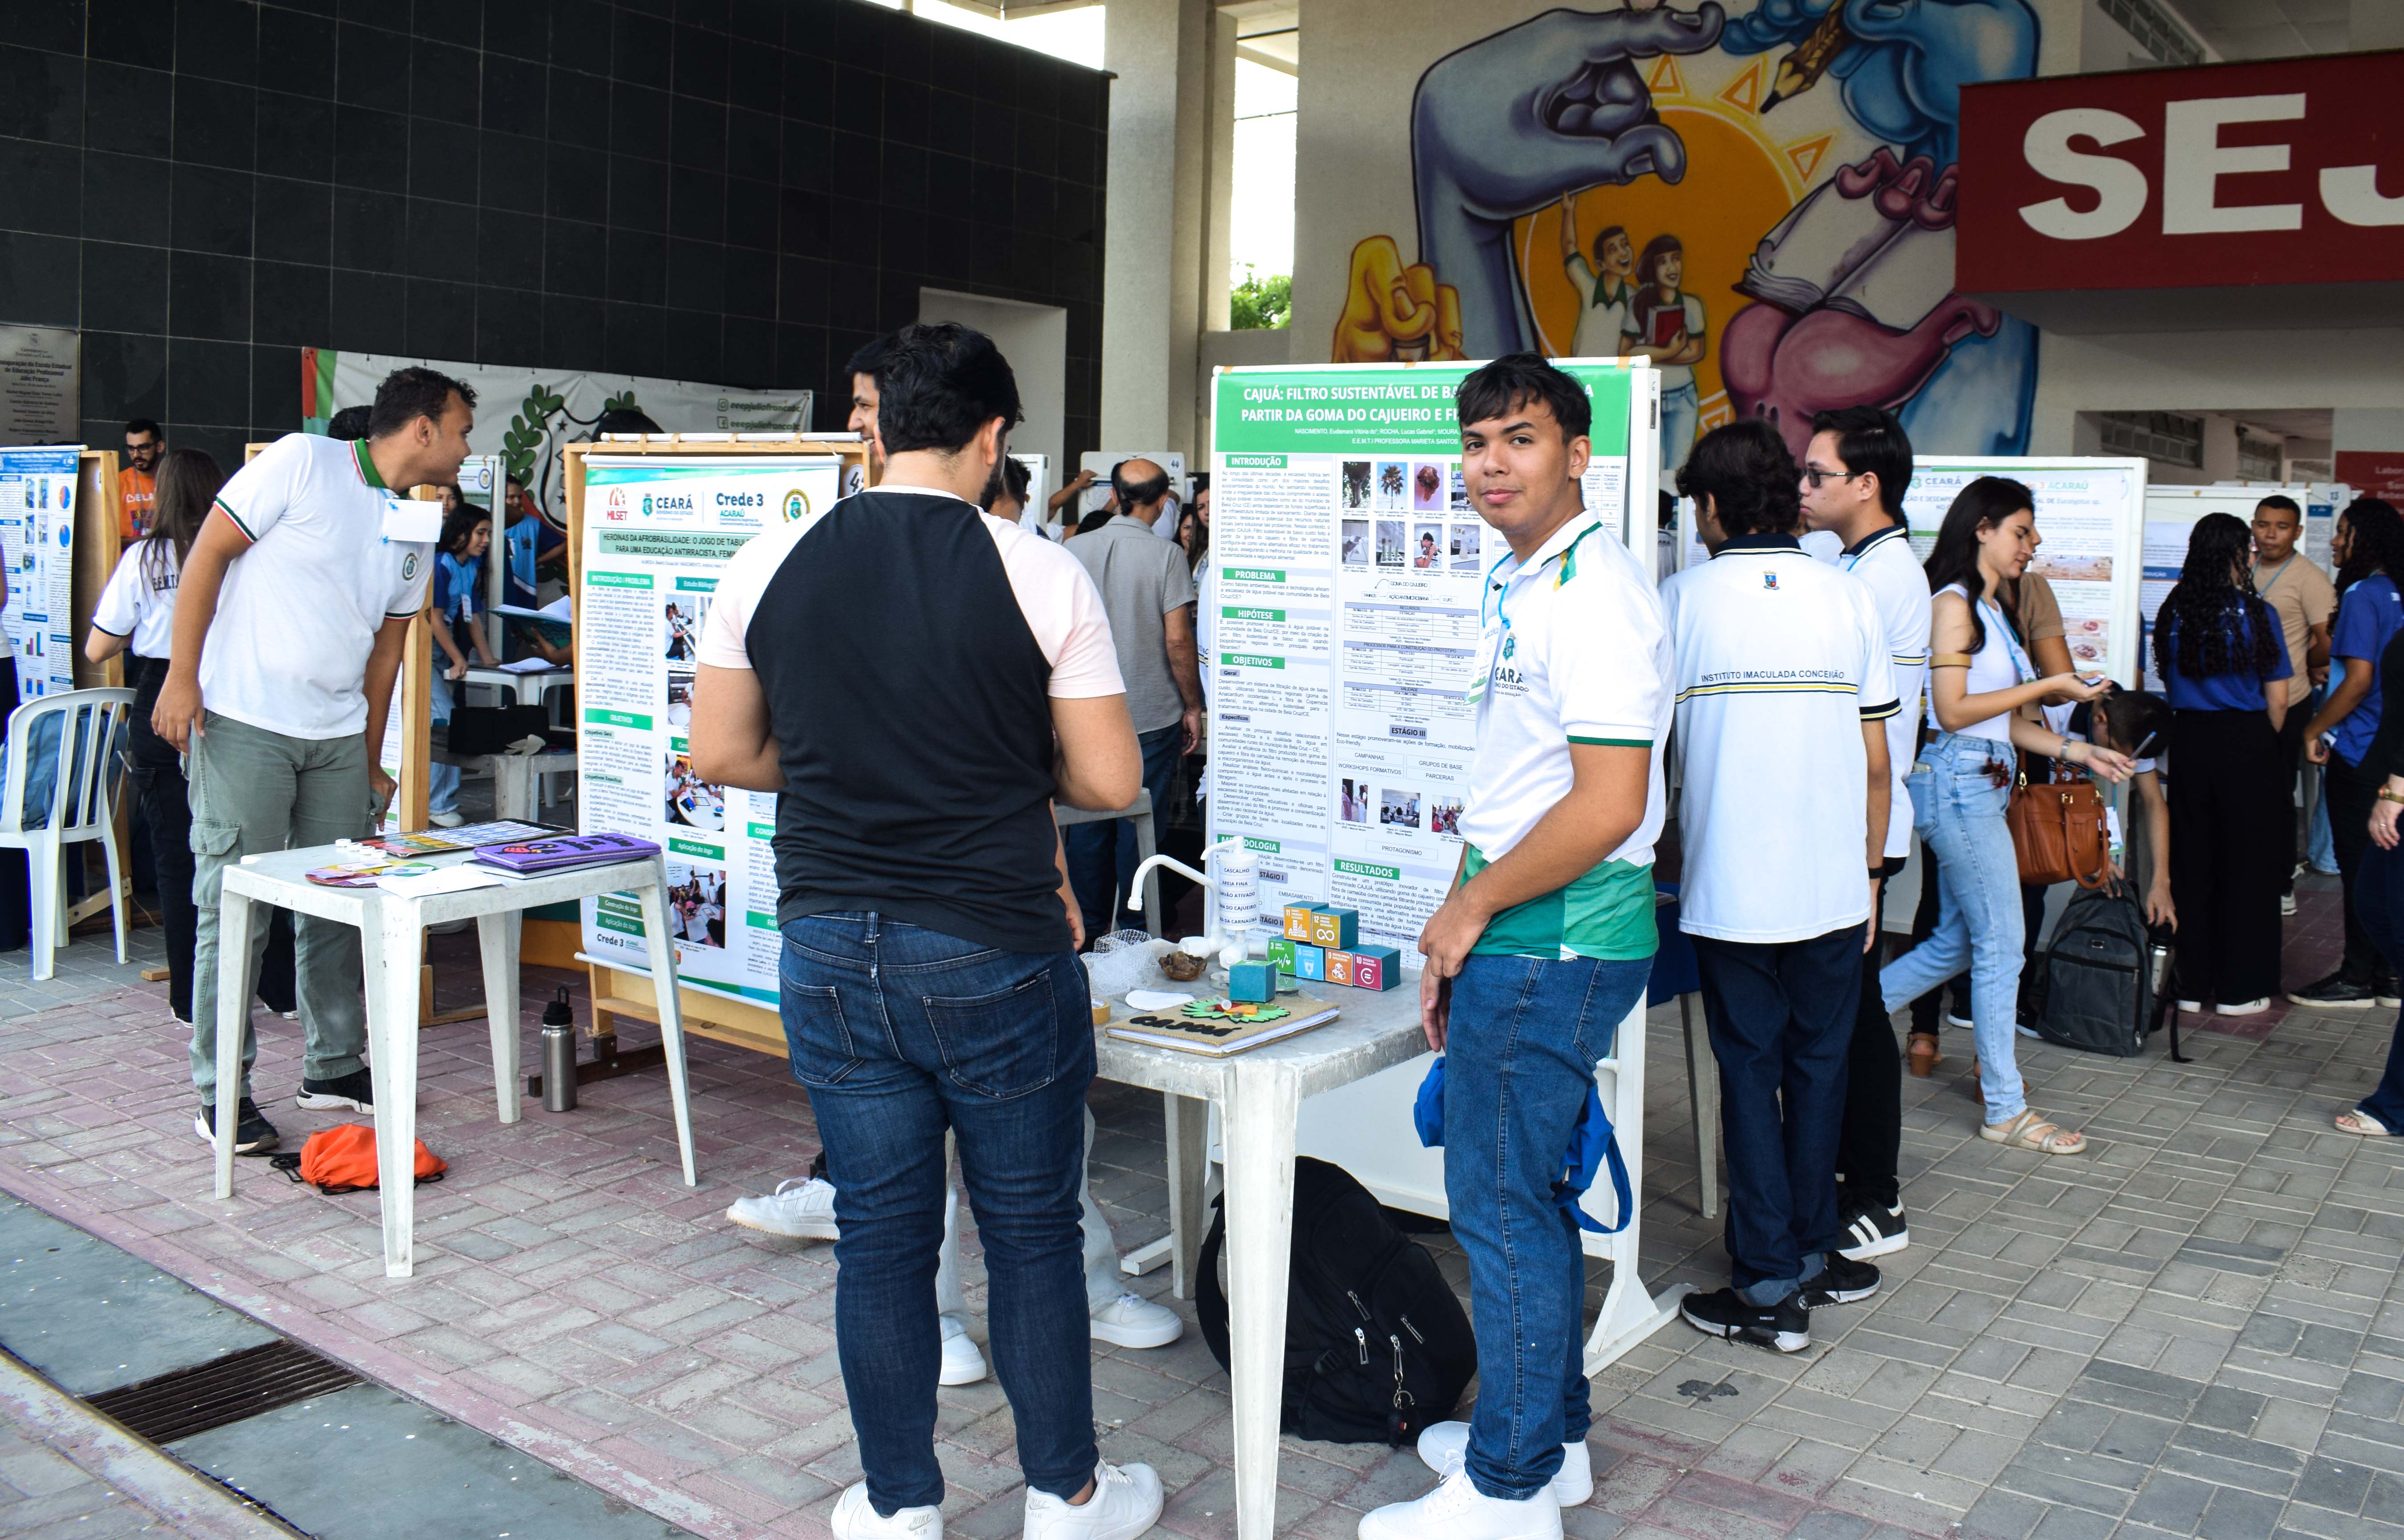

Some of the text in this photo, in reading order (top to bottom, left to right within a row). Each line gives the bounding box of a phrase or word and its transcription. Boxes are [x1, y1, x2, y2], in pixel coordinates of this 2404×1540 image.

[1244, 385, 1283, 403] CAJUÁ:
[1287, 386, 1328, 400] FILTRO
[1332, 384, 1417, 399] SUSTENTÁVEL
[1421, 386, 1438, 399] DE
[1242, 408, 1457, 423] PARTIR DA GOMA DO CAJUEIRO E FI
[1171, 460, 1180, 469] 44
[1231, 456, 1281, 467] INTRODUÇÃO
[850, 472, 864, 493] 4
[1925, 476, 1962, 485] CEARÁ
[2048, 480, 2089, 489] ACARAÚ
[656, 495, 693, 509] CEARÁ
[716, 493, 763, 506] Crede 3
[720, 509, 744, 517] ACARAÚ
[638, 535, 691, 543] AFROBRASILIDADE:
[727, 538, 750, 546] TABU
[643, 546, 673, 555] EDUCAÇÃO
[1235, 570, 1276, 579] PROBLEMA
[592, 575, 622, 584] INTRODUÇÃO
[1238, 609, 1273, 619] HIPÓTESE
[1233, 656, 1272, 666] OBJETIVOS
[1701, 671, 1741, 682] INSTITUTO
[1744, 671, 1796, 679] IMACULADA
[1510, 684, 1529, 692] ESTADO
[1392, 727, 1417, 736] ESTÁGIO
[1336, 738, 1362, 746] Eco-friendly.
[678, 843, 697, 851] Aplicação
[1222, 836, 1277, 851] MEDOLOGIA
[1382, 845, 1422, 855] PROTAGONISMO
[1340, 862, 1393, 877] RESULTADOS
[1332, 873, 1357, 881] Construiu-se
[1278, 891, 1313, 900] EMBASAMENTO
[597, 934, 624, 947] Crede 3
[1356, 956, 1362, 964] 10
